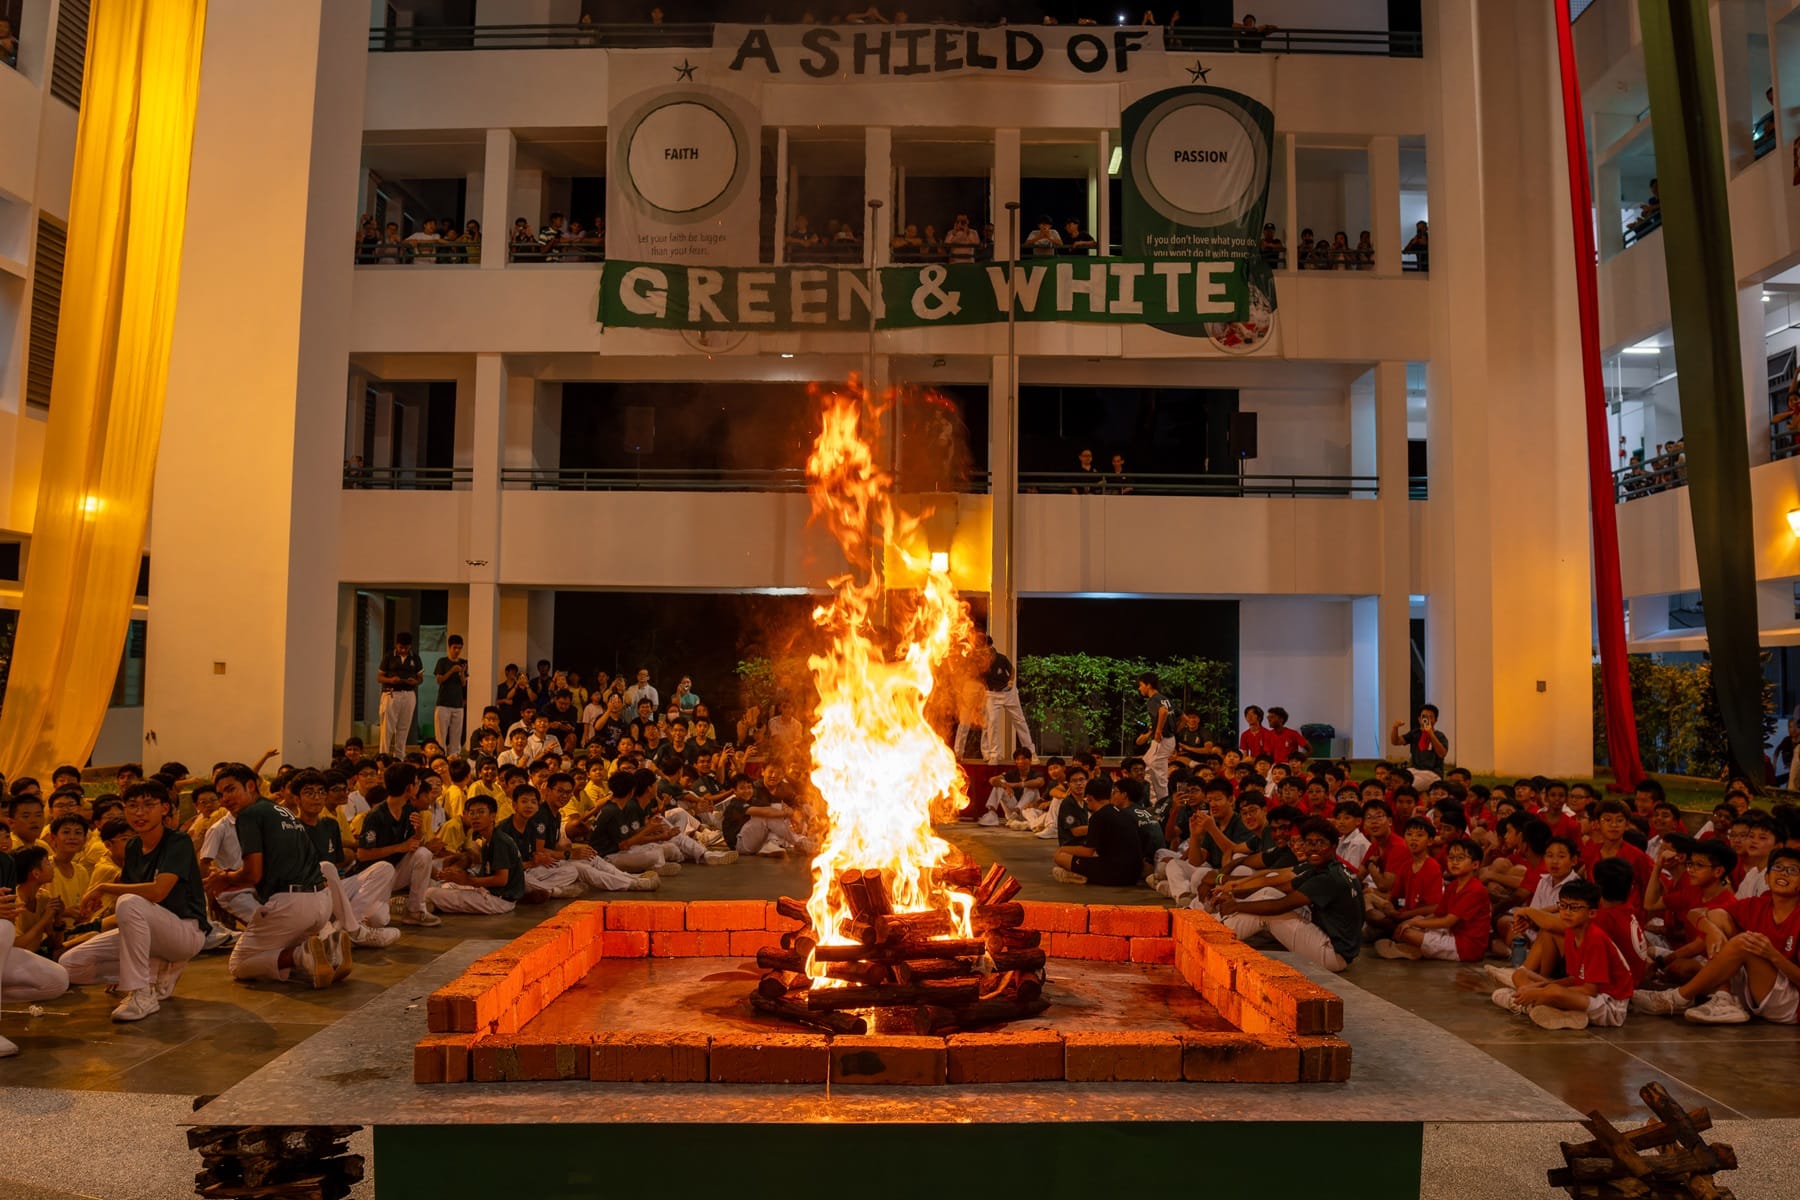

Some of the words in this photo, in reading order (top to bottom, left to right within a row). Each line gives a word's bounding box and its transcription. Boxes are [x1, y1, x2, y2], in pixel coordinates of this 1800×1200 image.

[729, 29, 781, 73] A
[799, 28, 1044, 78] SHIELD
[1066, 31, 1149, 73] OF
[664, 148, 699, 160] FAITH
[1174, 150, 1228, 163] PASSION
[638, 234, 649, 243] Let
[651, 235, 668, 245] your
[669, 232, 687, 242] faith
[688, 232, 699, 242] be
[700, 233, 727, 245] bigger
[1146, 234, 1153, 245] If
[1154, 237, 1169, 247] you
[1170, 234, 1192, 245] don't
[1193, 235, 1210, 245] love
[1211, 235, 1231, 245] what
[1231, 238, 1247, 248] you
[651, 246, 668, 256] than
[669, 247, 687, 258] your
[1169, 248, 1192, 257] won't
[1193, 248, 1204, 257] do
[1205, 248, 1211, 258] it
[1212, 248, 1230, 258] with
[619, 266, 886, 323] GREEN
[911, 265, 962, 320] &
[986, 262, 1236, 315] WHITE
